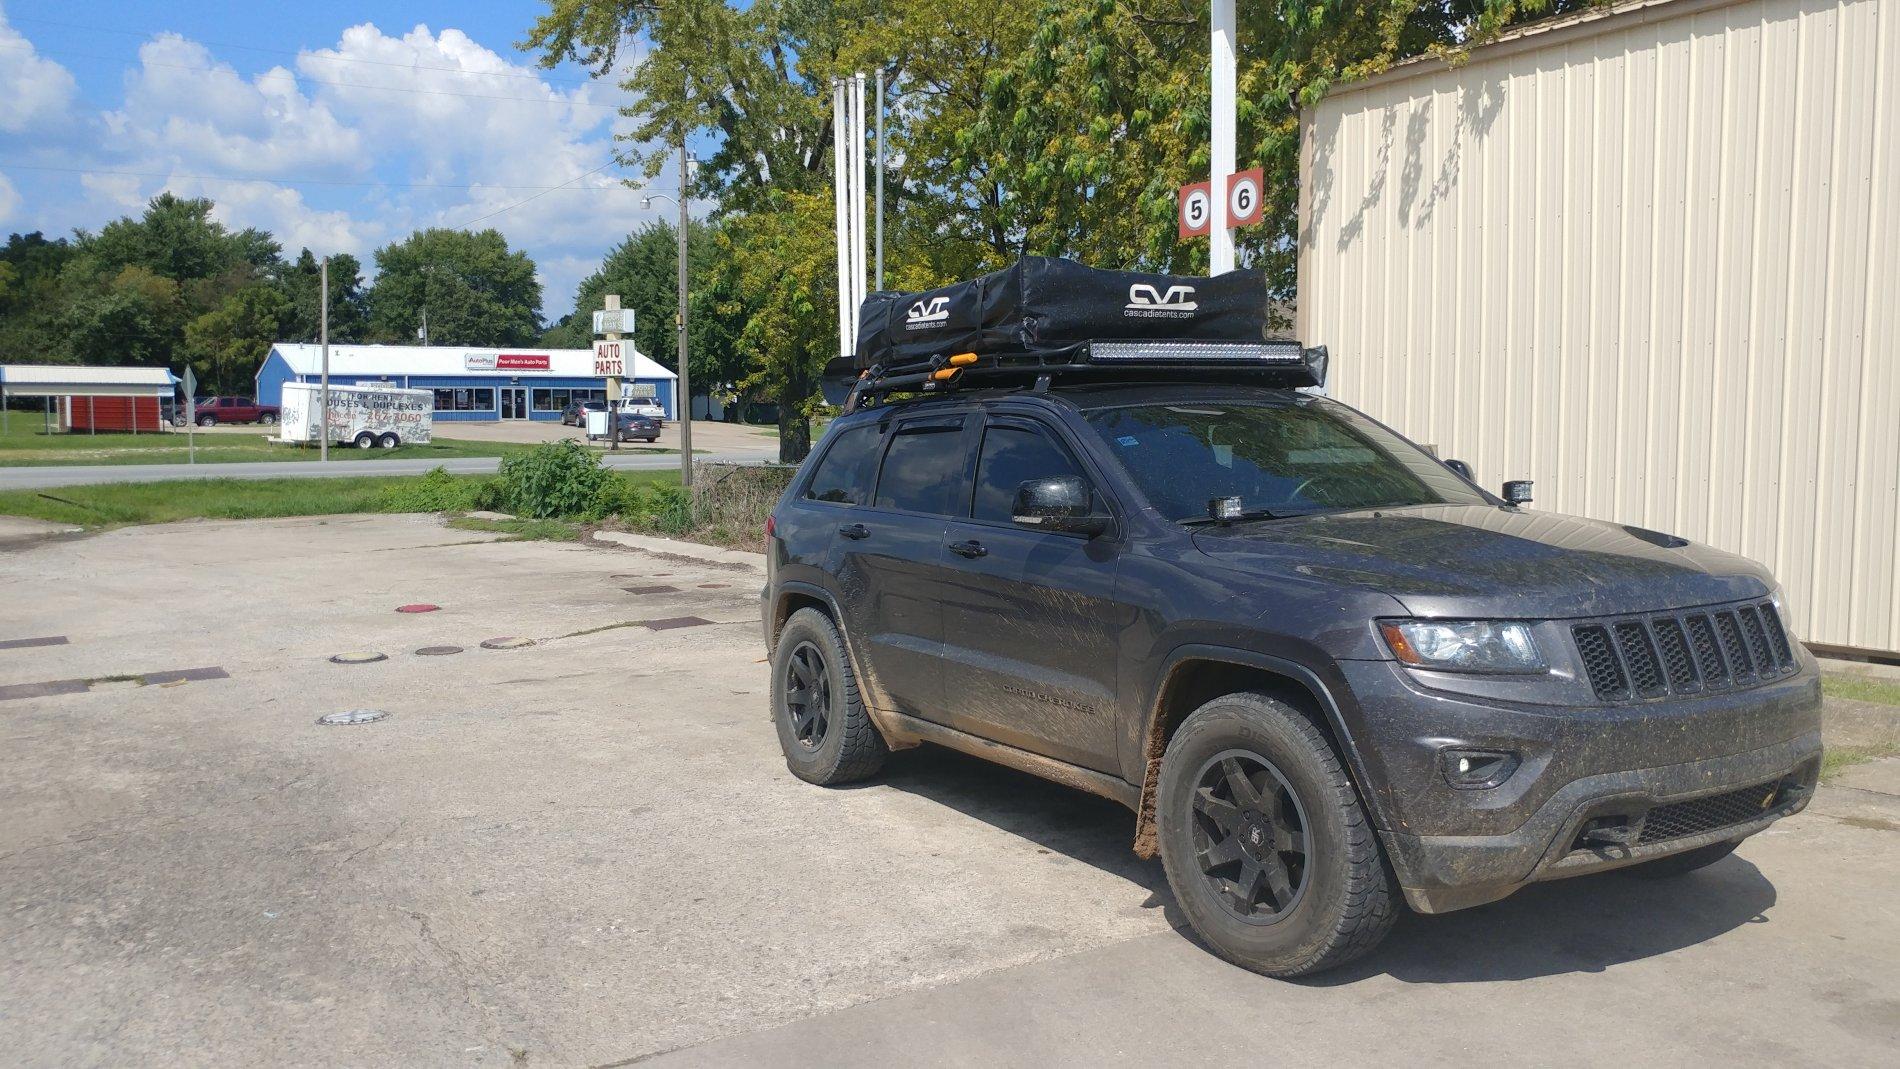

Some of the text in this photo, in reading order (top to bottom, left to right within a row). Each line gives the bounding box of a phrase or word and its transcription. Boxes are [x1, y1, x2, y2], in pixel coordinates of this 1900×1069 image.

[1238, 188, 1250, 210] 6
[1191, 199, 1202, 220] 5
[1128, 284, 1196, 307] CVT
[907, 297, 949, 320] CVT
[597, 343, 620, 359] AUTO
[595, 360, 623, 375] PARTS
[318, 398, 359, 408] OUSES
[373, 401, 424, 411] DUPLEXES
[351, 393, 393, 402] FOR RENT
